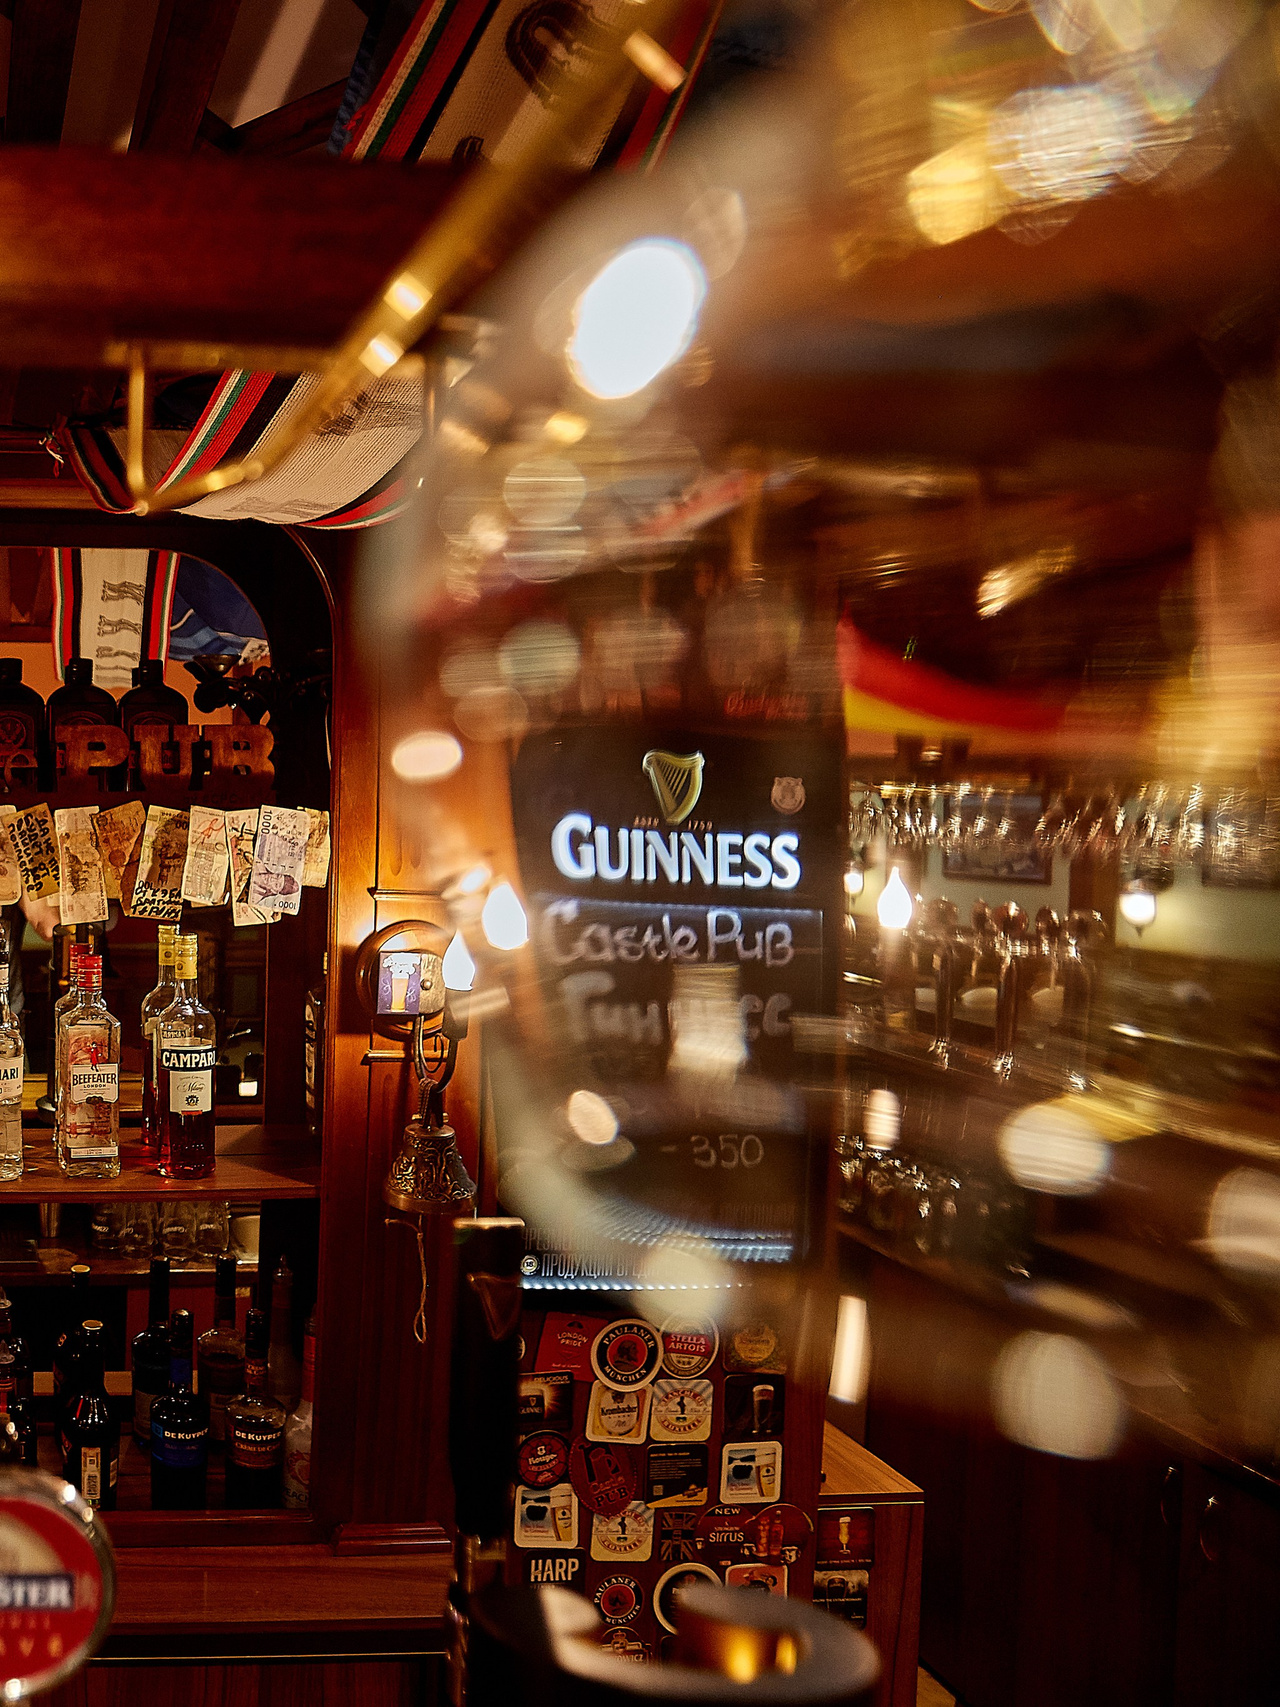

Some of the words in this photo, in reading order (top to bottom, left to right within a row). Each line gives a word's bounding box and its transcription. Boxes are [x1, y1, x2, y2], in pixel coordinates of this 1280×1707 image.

[54, 724, 277, 793] PUB
[261, 809, 274, 836] 1000
[551, 811, 802, 889] GUINNESS
[72, 1073, 117, 1086] BEEFEATER
[690, 1133, 765, 1169] 350
[557, 1331, 589, 1344] LONDON
[603, 1326, 655, 1349] PAULANER
[669, 1343, 706, 1353] ARTOIS
[670, 1333, 706, 1345] STELLA
[594, 1486, 630, 1509] PUB
[715, 1507, 741, 1515] NEW
[530, 1558, 579, 1582] HARP
[594, 1577, 636, 1603] PAULANER
